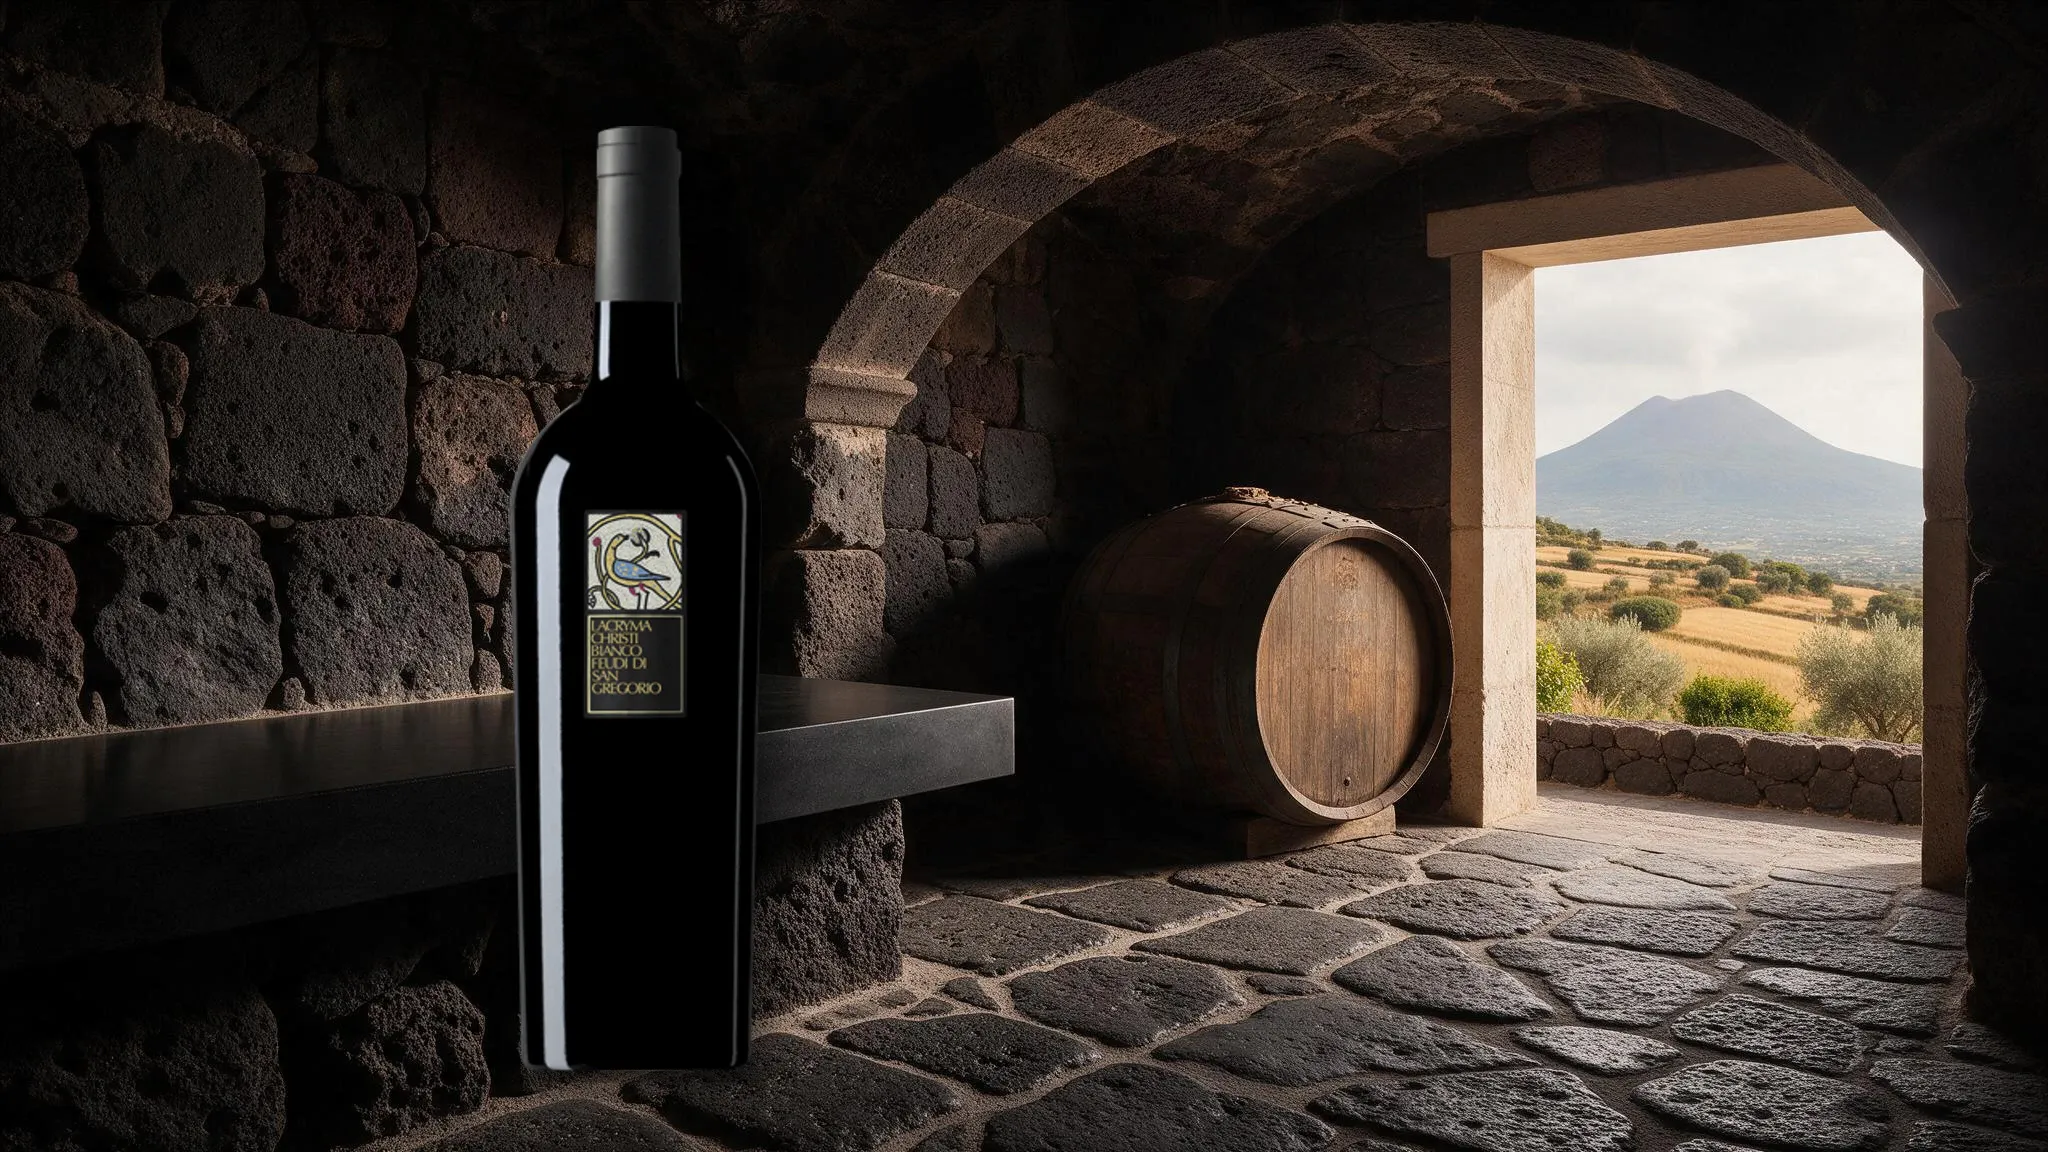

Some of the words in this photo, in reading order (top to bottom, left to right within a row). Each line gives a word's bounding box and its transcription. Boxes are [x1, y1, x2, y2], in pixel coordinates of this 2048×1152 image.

[591, 619, 653, 632] LACRYMA
[591, 633, 639, 644] CHRISTI
[591, 645, 643, 657] BIANCO
[591, 657, 628, 669] FEUDI
[632, 657, 647, 669] DI
[592, 670, 619, 681] SAN
[591, 682, 662, 694] GREGORIO
